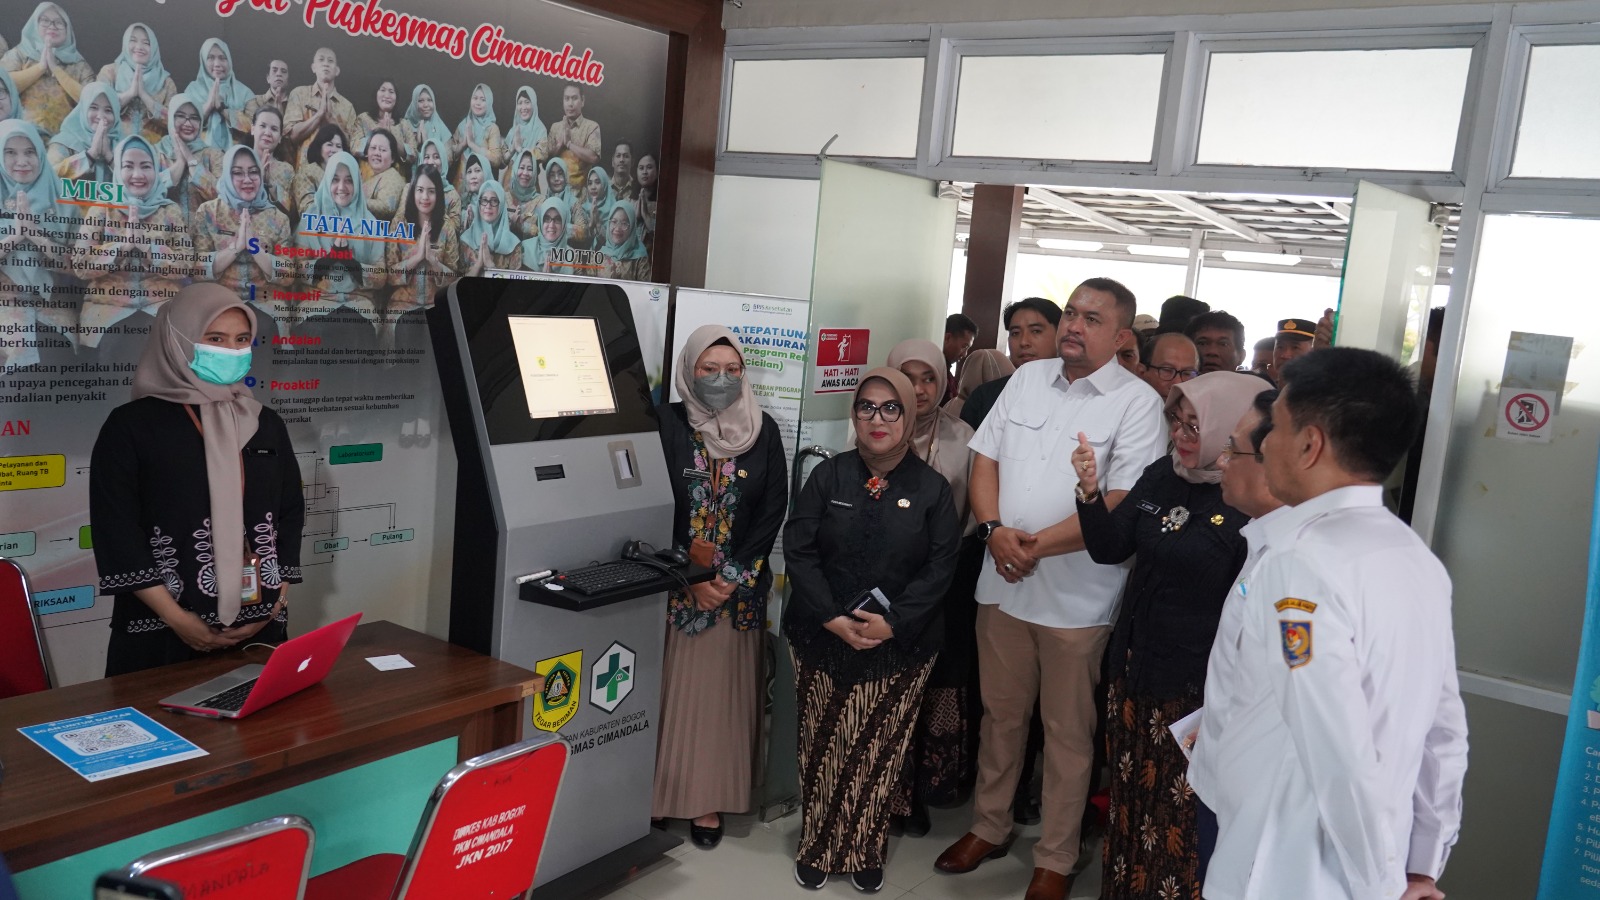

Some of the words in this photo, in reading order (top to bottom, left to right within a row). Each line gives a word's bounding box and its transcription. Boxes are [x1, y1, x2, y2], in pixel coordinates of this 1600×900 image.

[305, 0, 466, 57] Puskesmas
[470, 24, 603, 85] Cimandala
[61, 178, 124, 203] MISI
[0, 209, 41, 225] orong
[44, 213, 121, 229] kemandirian
[124, 221, 188, 234] masyarakat
[303, 213, 355, 234] TATA
[360, 219, 414, 239] NILAI
[0, 225, 16, 235] ah
[20, 226, 88, 241] Puskesmas
[91, 231, 151, 245] Cimandala
[50, 246, 86, 257] upaya
[89, 246, 147, 258] kesehatan
[151, 251, 212, 264] masyarakat
[248, 238, 260, 254] S
[274, 244, 327, 259] Sepenuh
[329, 247, 353, 260] hati
[551, 248, 604, 265] MOTTO
[11, 257, 67, 271] individu,
[70, 260, 121, 273] keluarga
[124, 263, 145, 273] dan
[148, 264, 207, 278] lingkungan
[275, 260, 303, 271] Bekerja
[325, 273, 344, 282] tinggi
[0, 282, 41, 294] orong
[43, 283, 105, 296] kemitraan
[108, 286, 149, 298] dengan
[273, 290, 321, 302] Inovatif
[14, 297, 77, 309] kesehatan
[274, 305, 335, 314] Mendayagunakan
[274, 316, 304, 324] program
[307, 316, 340, 324] kesehatan
[61, 325, 120, 337] pelayanan
[743, 326, 779, 336] TEPAT
[0, 337, 71, 349] berkualitas
[271, 335, 321, 346] Andalan
[738, 336, 770, 346] AKAN
[272, 347, 305, 357] Terampil
[306, 348, 330, 356] handal
[743, 347, 787, 359] Program
[272, 358, 318, 367] menjalankan
[319, 358, 338, 367] tugas
[361, 357, 384, 366] dengan
[746, 358, 783, 371] Cicilan)
[60, 362, 110, 375] perilaku
[823, 369, 839, 377] HATI
[844, 368, 859, 377] HATI
[9, 380, 46, 390] upaya
[50, 377, 119, 390] pencegahan
[270, 379, 320, 391] Proaktif
[821, 378, 840, 388] AWAS
[55, 391, 106, 404] penyakit
[271, 397, 291, 406] Cepat
[292, 396, 320, 406] tanggap
[321, 395, 334, 403] dan
[336, 395, 353, 404] tepat
[354, 394, 374, 402] waktu
[375, 393, 415, 401] memberikan
[308, 405, 343, 414] kesehatan
[344, 404, 364, 412] sesuai
[366, 403, 399, 411] kebutuhan
[1, 420, 31, 437] AN
[382, 533, 403, 542] Pulang
[324, 542, 339, 550] Obat
[535, 712, 551, 728] TEGAR
[552, 700, 577, 728] BERIMAN
[580, 718, 621, 739] KABUPATEN
[622, 710, 646, 724] BOGOR
[597, 720, 650, 746] CIMANDALA
[1586, 760, 1594, 769] 1.
[1584, 773, 1592, 781] 2.
[1582, 785, 1590, 794] 3.
[481, 815, 499, 830] KAB
[498, 804, 526, 824] BOGOR
[1577, 822, 1585, 830] 5.
[453, 839, 472, 856] PKM
[471, 824, 514, 848] CIMANDALA
[1575, 835, 1583, 843] 6.
[456, 849, 484, 869] JKN
[484, 838, 514, 858] 2017
[1574, 848, 1581, 856] 7.
